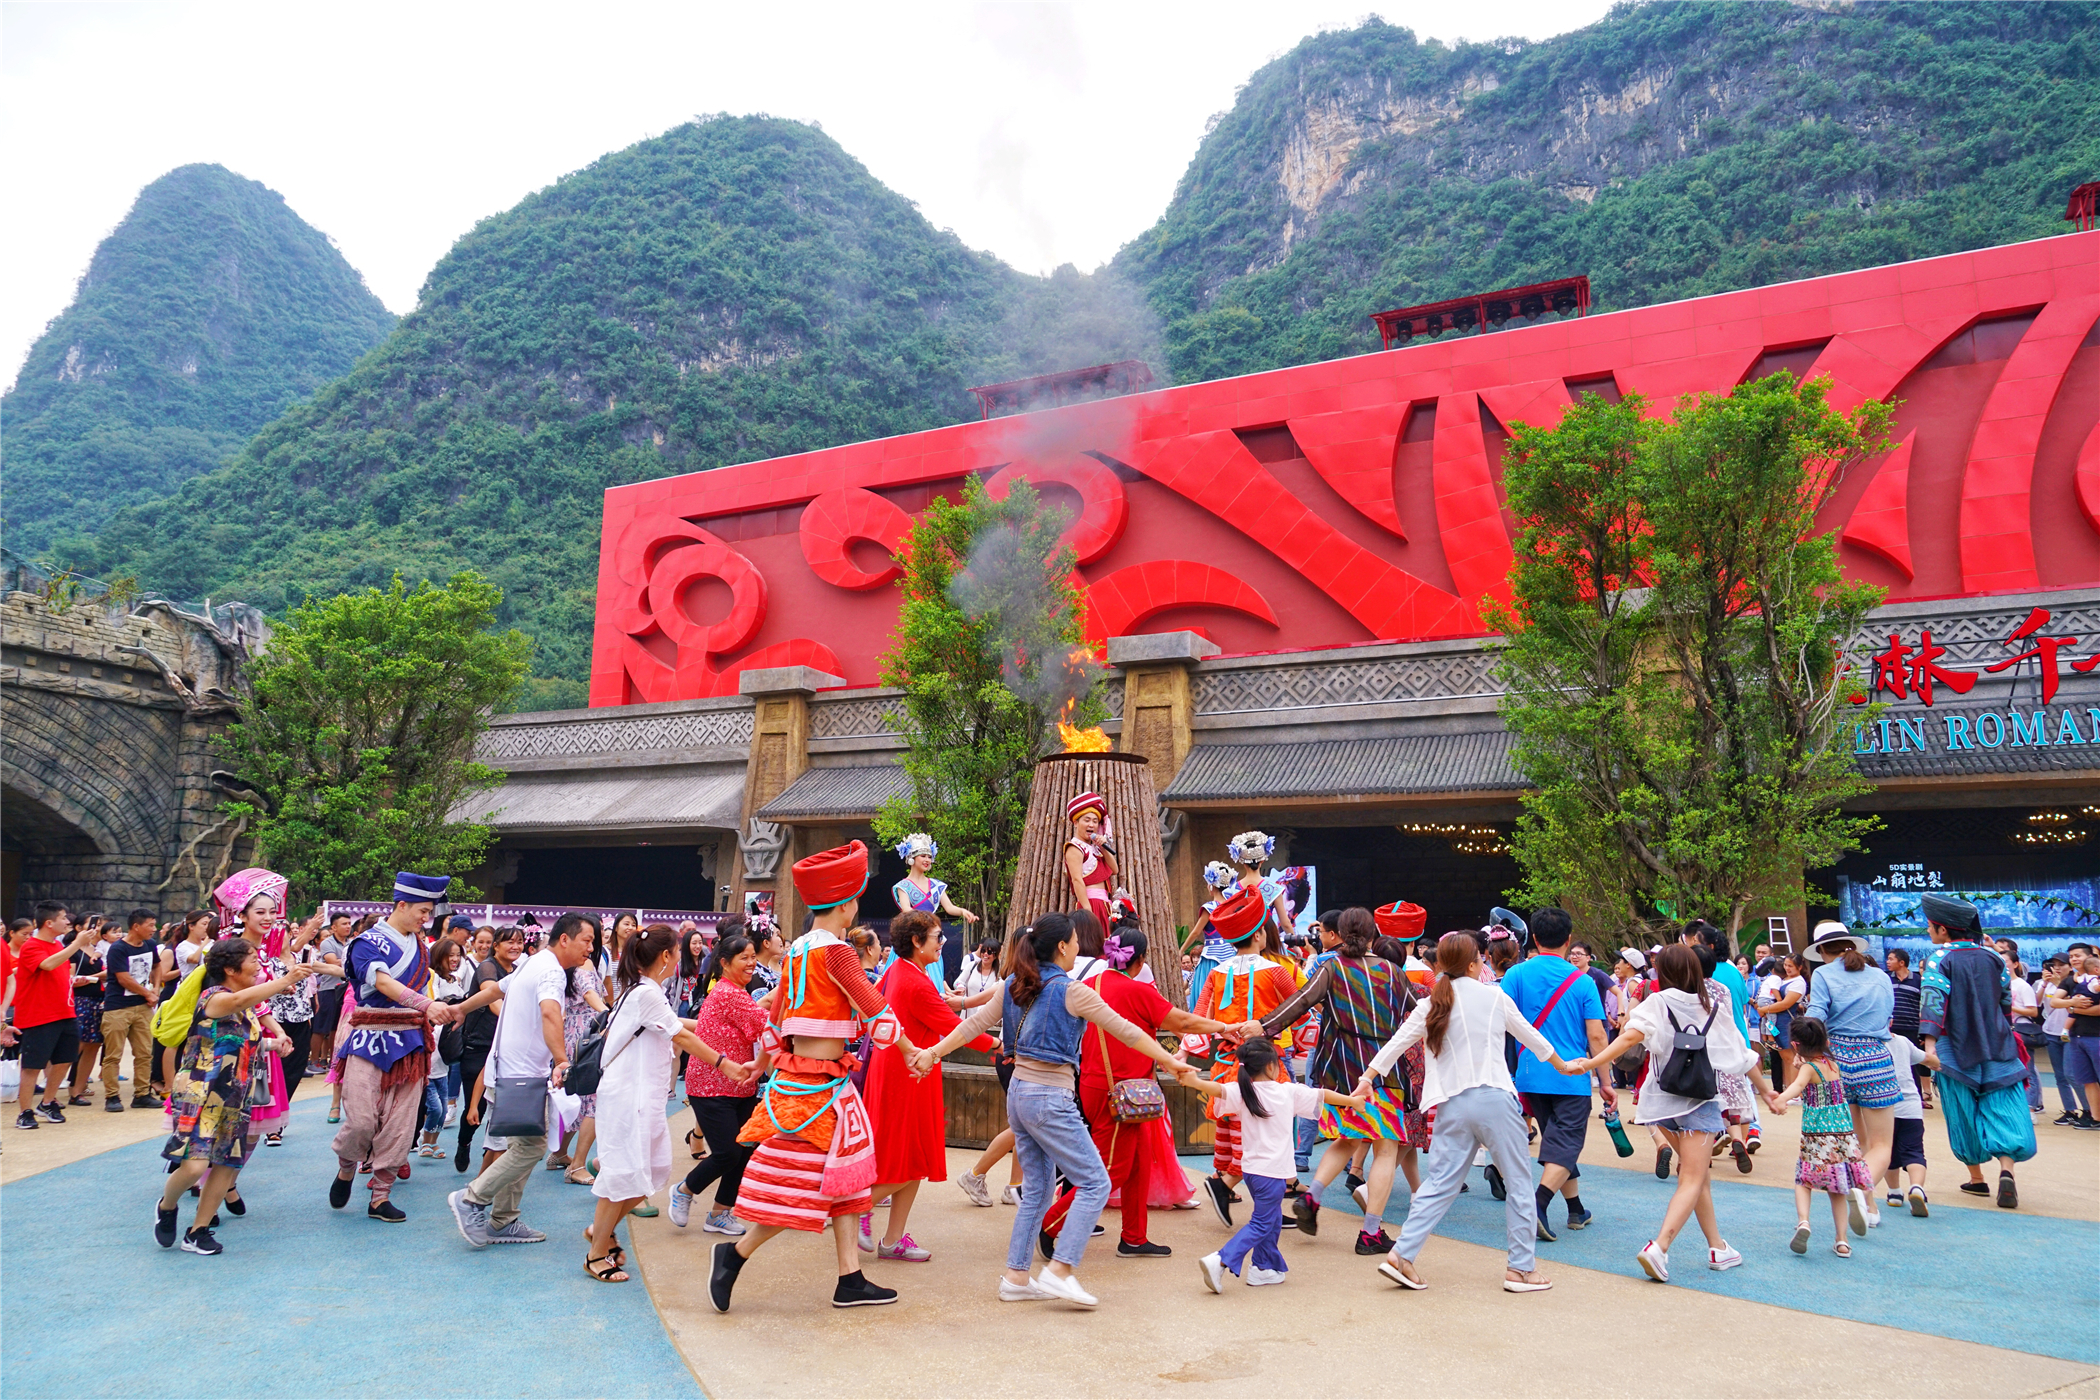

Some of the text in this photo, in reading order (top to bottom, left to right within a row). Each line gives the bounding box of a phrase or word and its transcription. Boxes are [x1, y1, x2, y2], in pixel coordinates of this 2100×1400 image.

[1822, 607, 2100, 707] 林千
[1872, 871, 1945, 889] 山崩地裂
